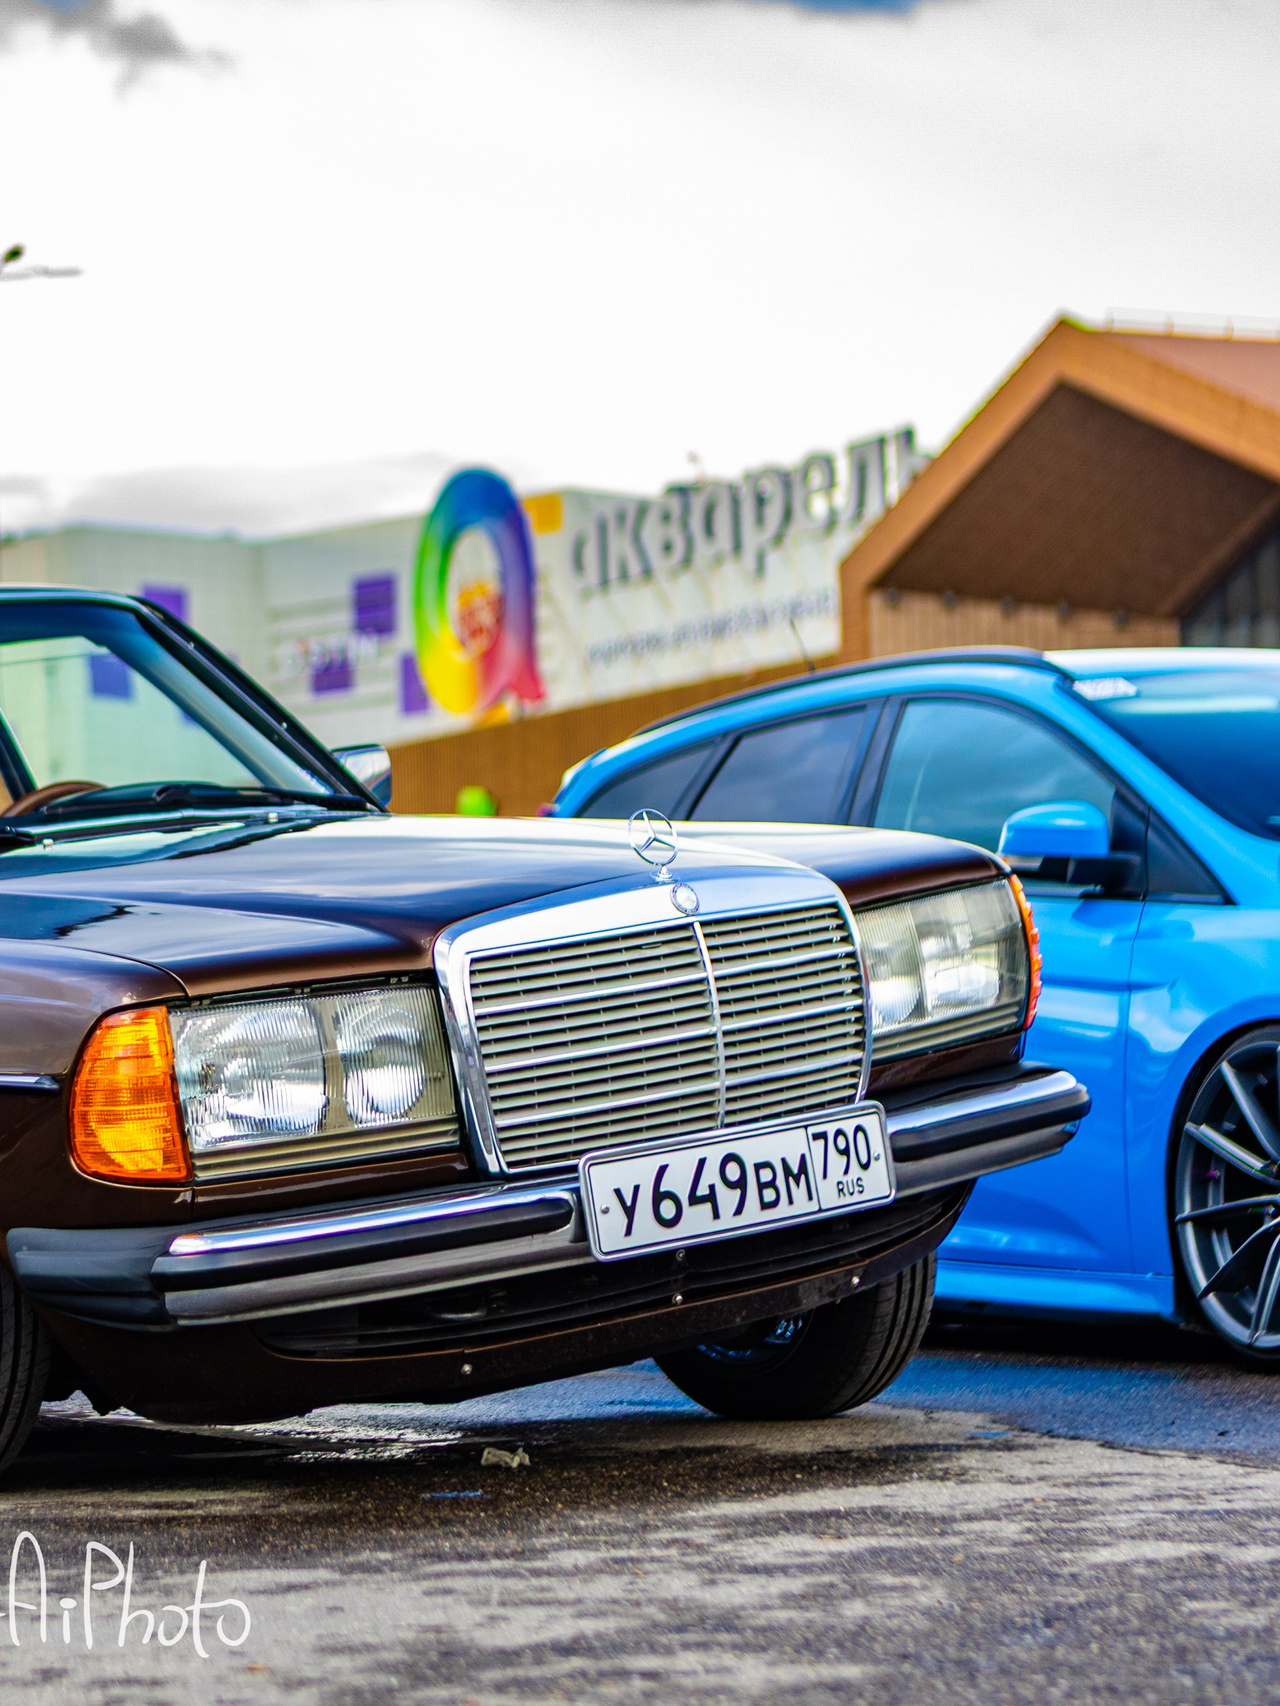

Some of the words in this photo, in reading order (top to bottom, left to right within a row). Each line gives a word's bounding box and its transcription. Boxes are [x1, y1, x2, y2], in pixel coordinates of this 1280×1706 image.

[613, 1152, 814, 1237] У649ВМ
[811, 1123, 872, 1181] 790
[836, 1177, 866, 1199] RUS
